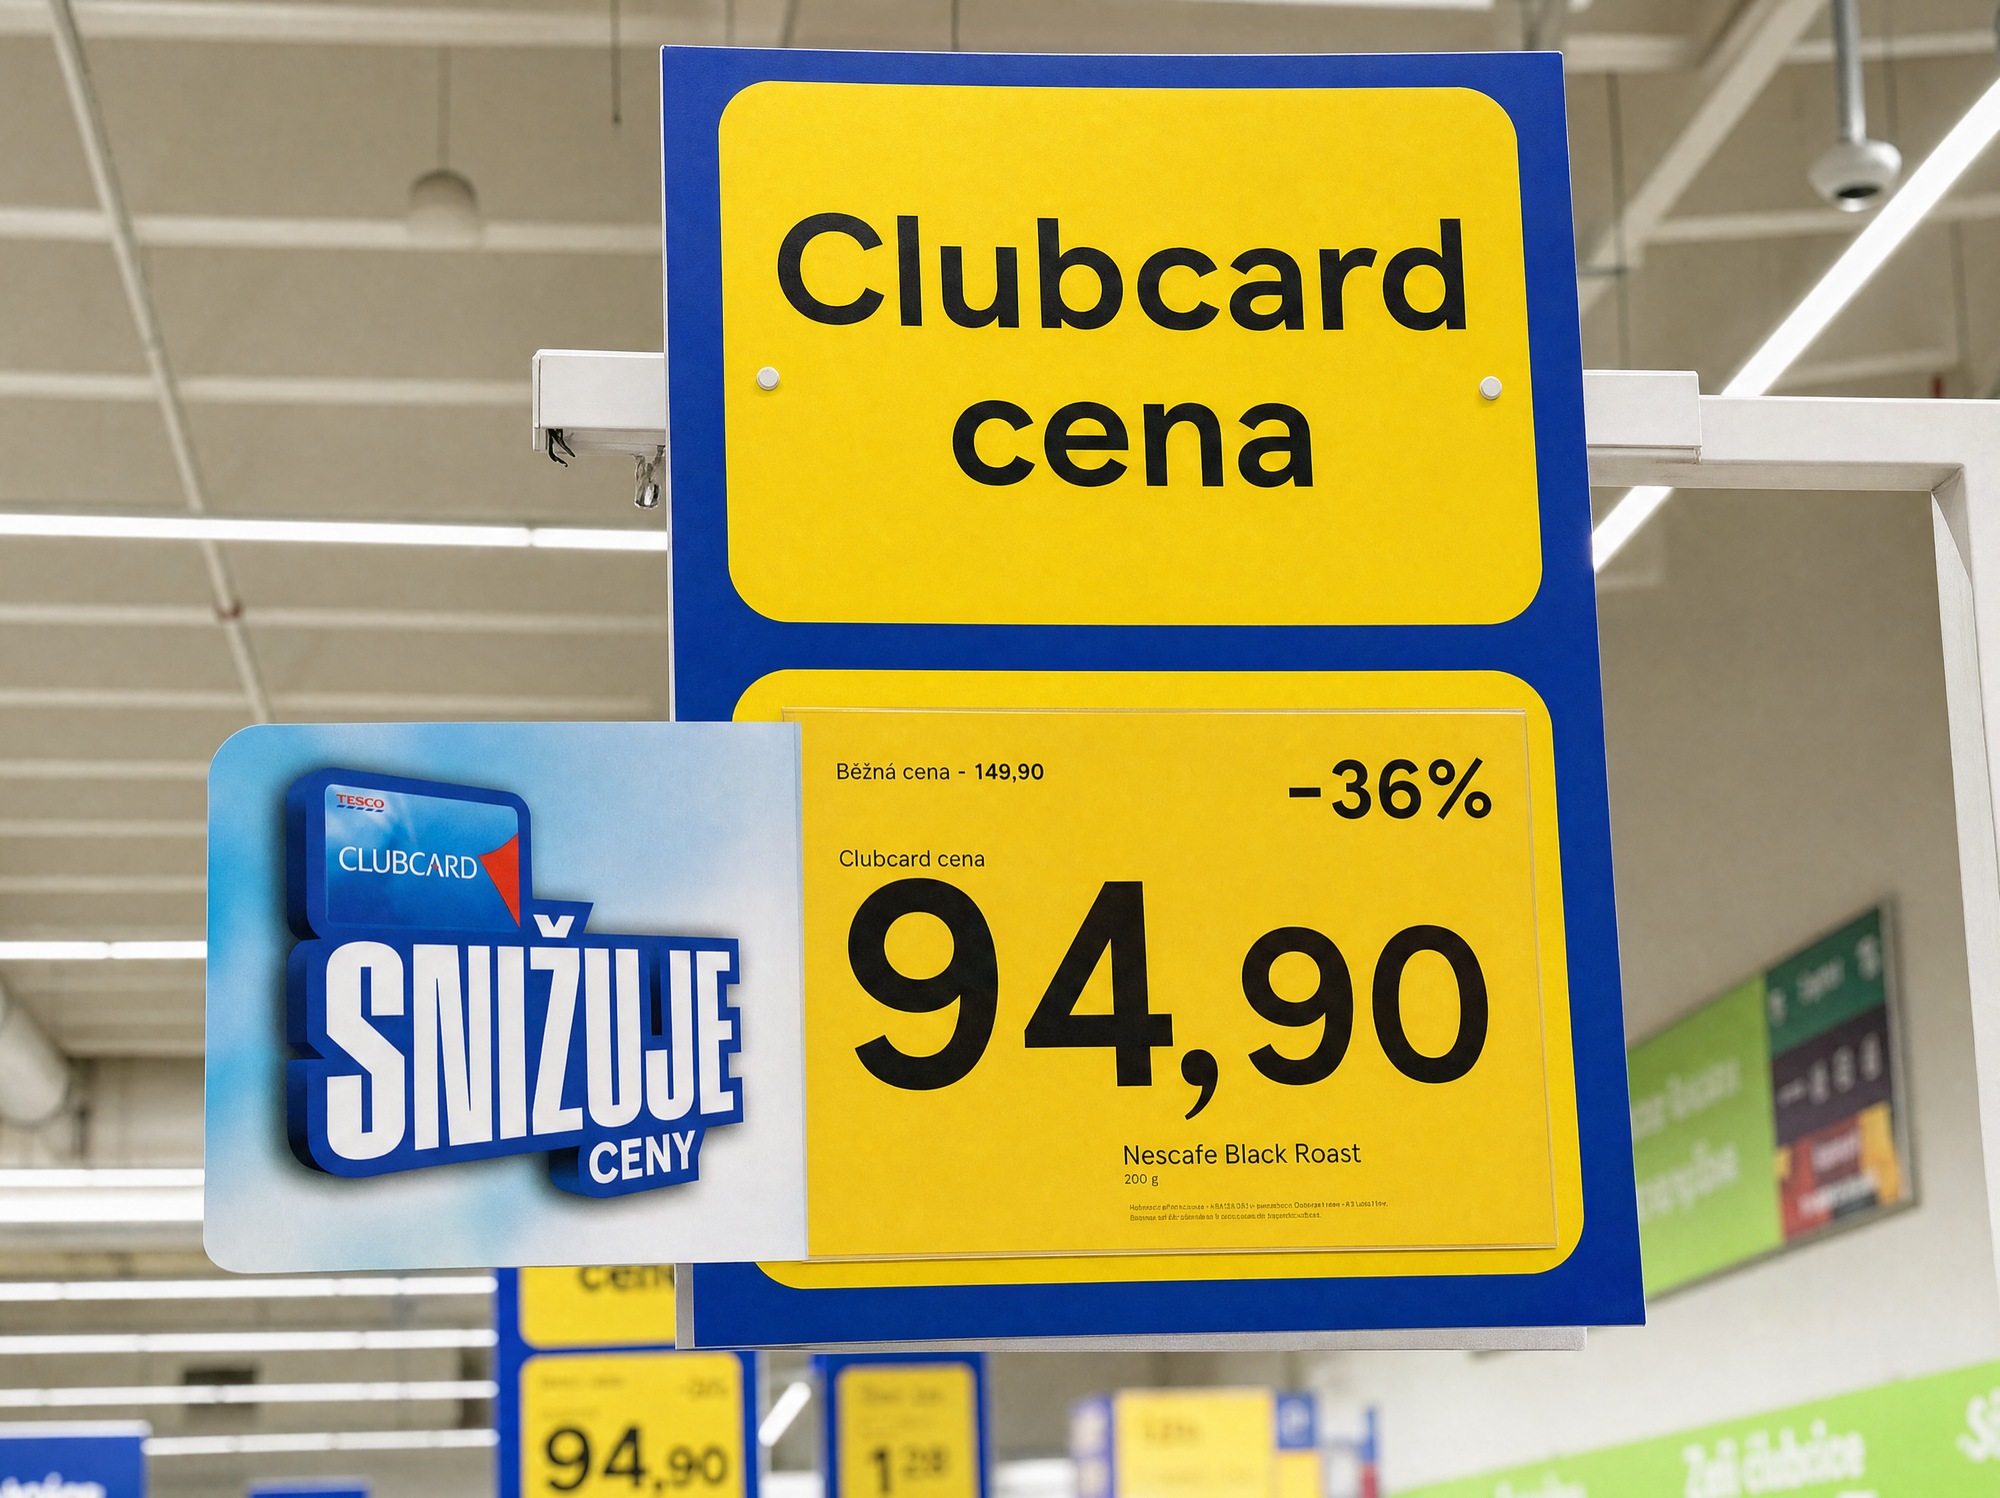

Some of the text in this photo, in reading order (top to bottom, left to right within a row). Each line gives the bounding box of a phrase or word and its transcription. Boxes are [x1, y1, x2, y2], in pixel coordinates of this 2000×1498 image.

[777, 212, 1467, 332] Clubcard
[952, 399, 1314, 488] cena
[836, 760, 896, 780] Běžná
[902, 766, 950, 780] cena
[974, 763, 1045, 784] 149,90
[1288, 757, 1492, 820] -36%
[336, 794, 385, 809] TESCO
[338, 846, 478, 879] CLUBCARD
[839, 849, 985, 868] Clubcard cena
[847, 877, 1489, 1121] 94,90
[325, 914, 735, 1161] SNIŽUJE
[589, 1130, 696, 1184] CENY
[1123, 1143, 1362, 1166] Nescafe Black Roast
[1124, 1173, 1159, 1187] 200 g
[545, 1425, 729, 1497] 94,90
